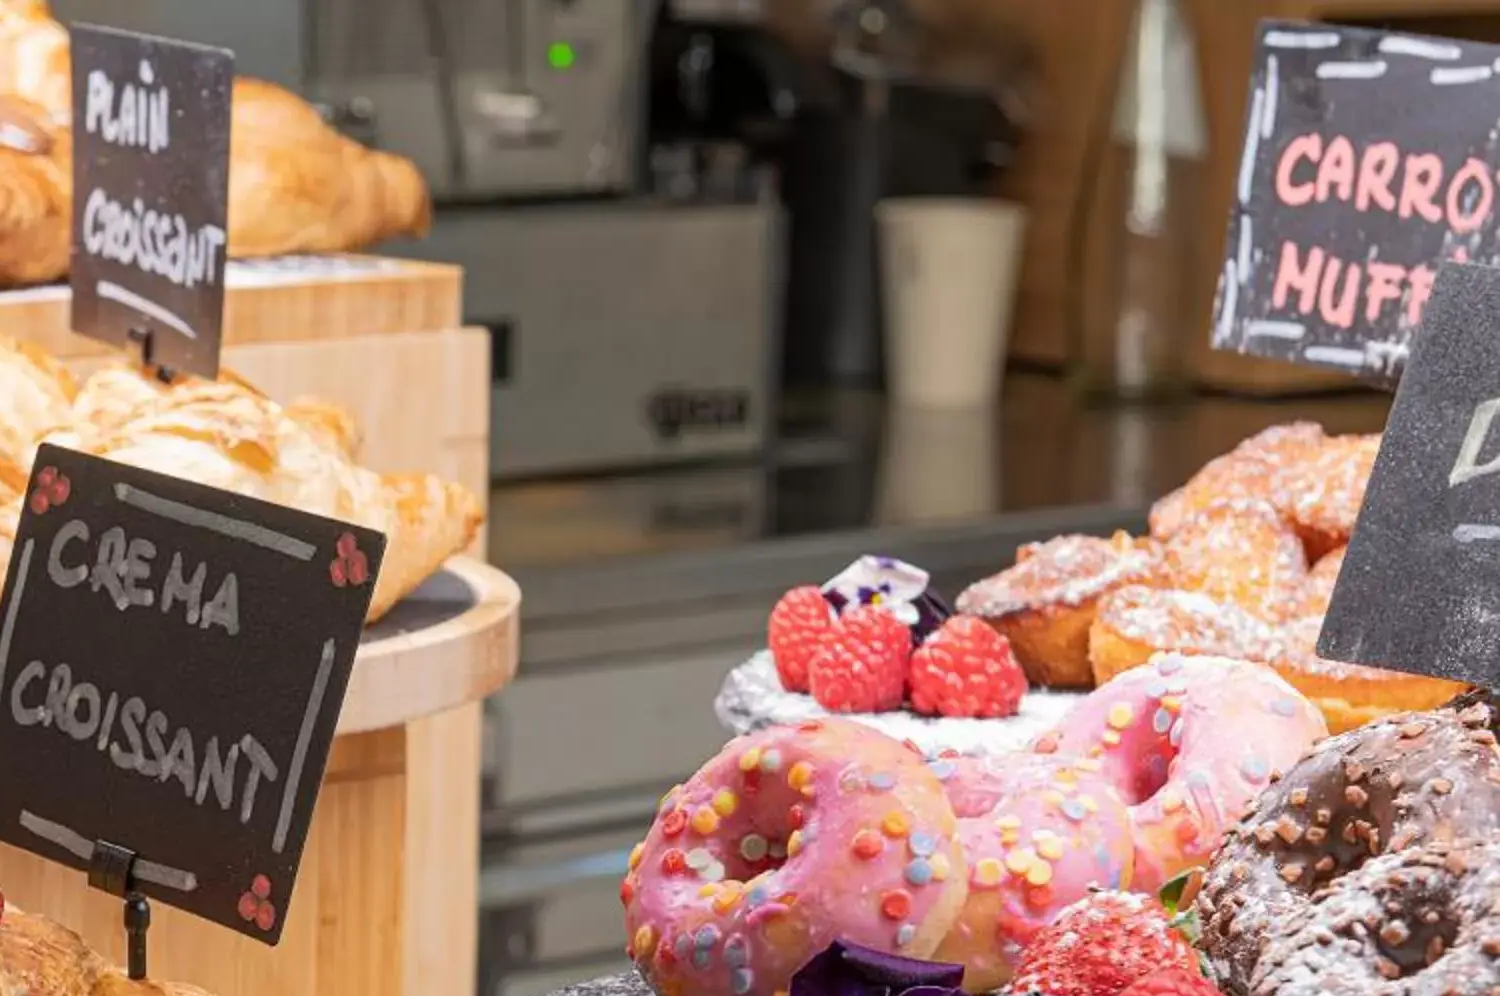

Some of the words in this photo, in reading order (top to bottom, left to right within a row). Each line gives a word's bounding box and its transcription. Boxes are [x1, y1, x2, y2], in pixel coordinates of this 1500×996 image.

[1275, 132, 1500, 234] CARRO
[1272, 239, 1468, 329] MUFF
[48, 519, 240, 636] CREMA
[11, 660, 278, 825] CROISSANT
